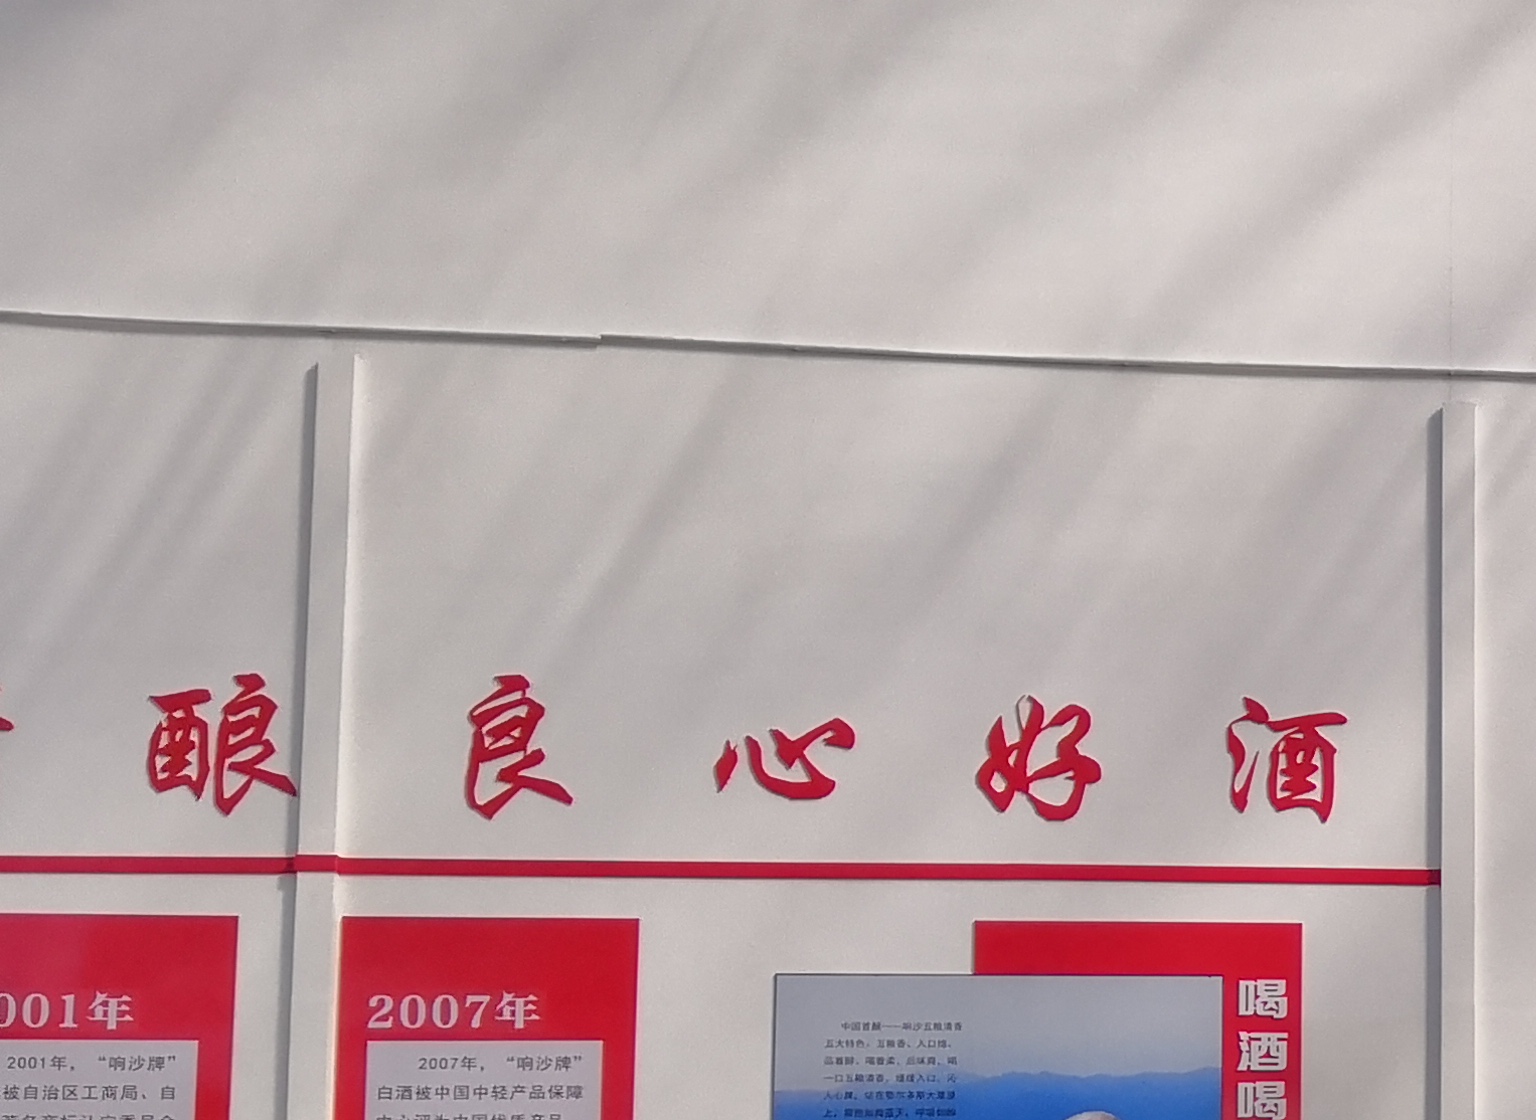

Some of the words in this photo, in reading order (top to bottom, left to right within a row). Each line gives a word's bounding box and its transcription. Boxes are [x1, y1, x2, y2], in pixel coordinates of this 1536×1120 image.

[0, 672, 1347, 823] 酿良心好酒
[367, 991, 541, 1029] 2007年
[377, 1085, 584, 1101] 白酒被中国中轻产品保障
